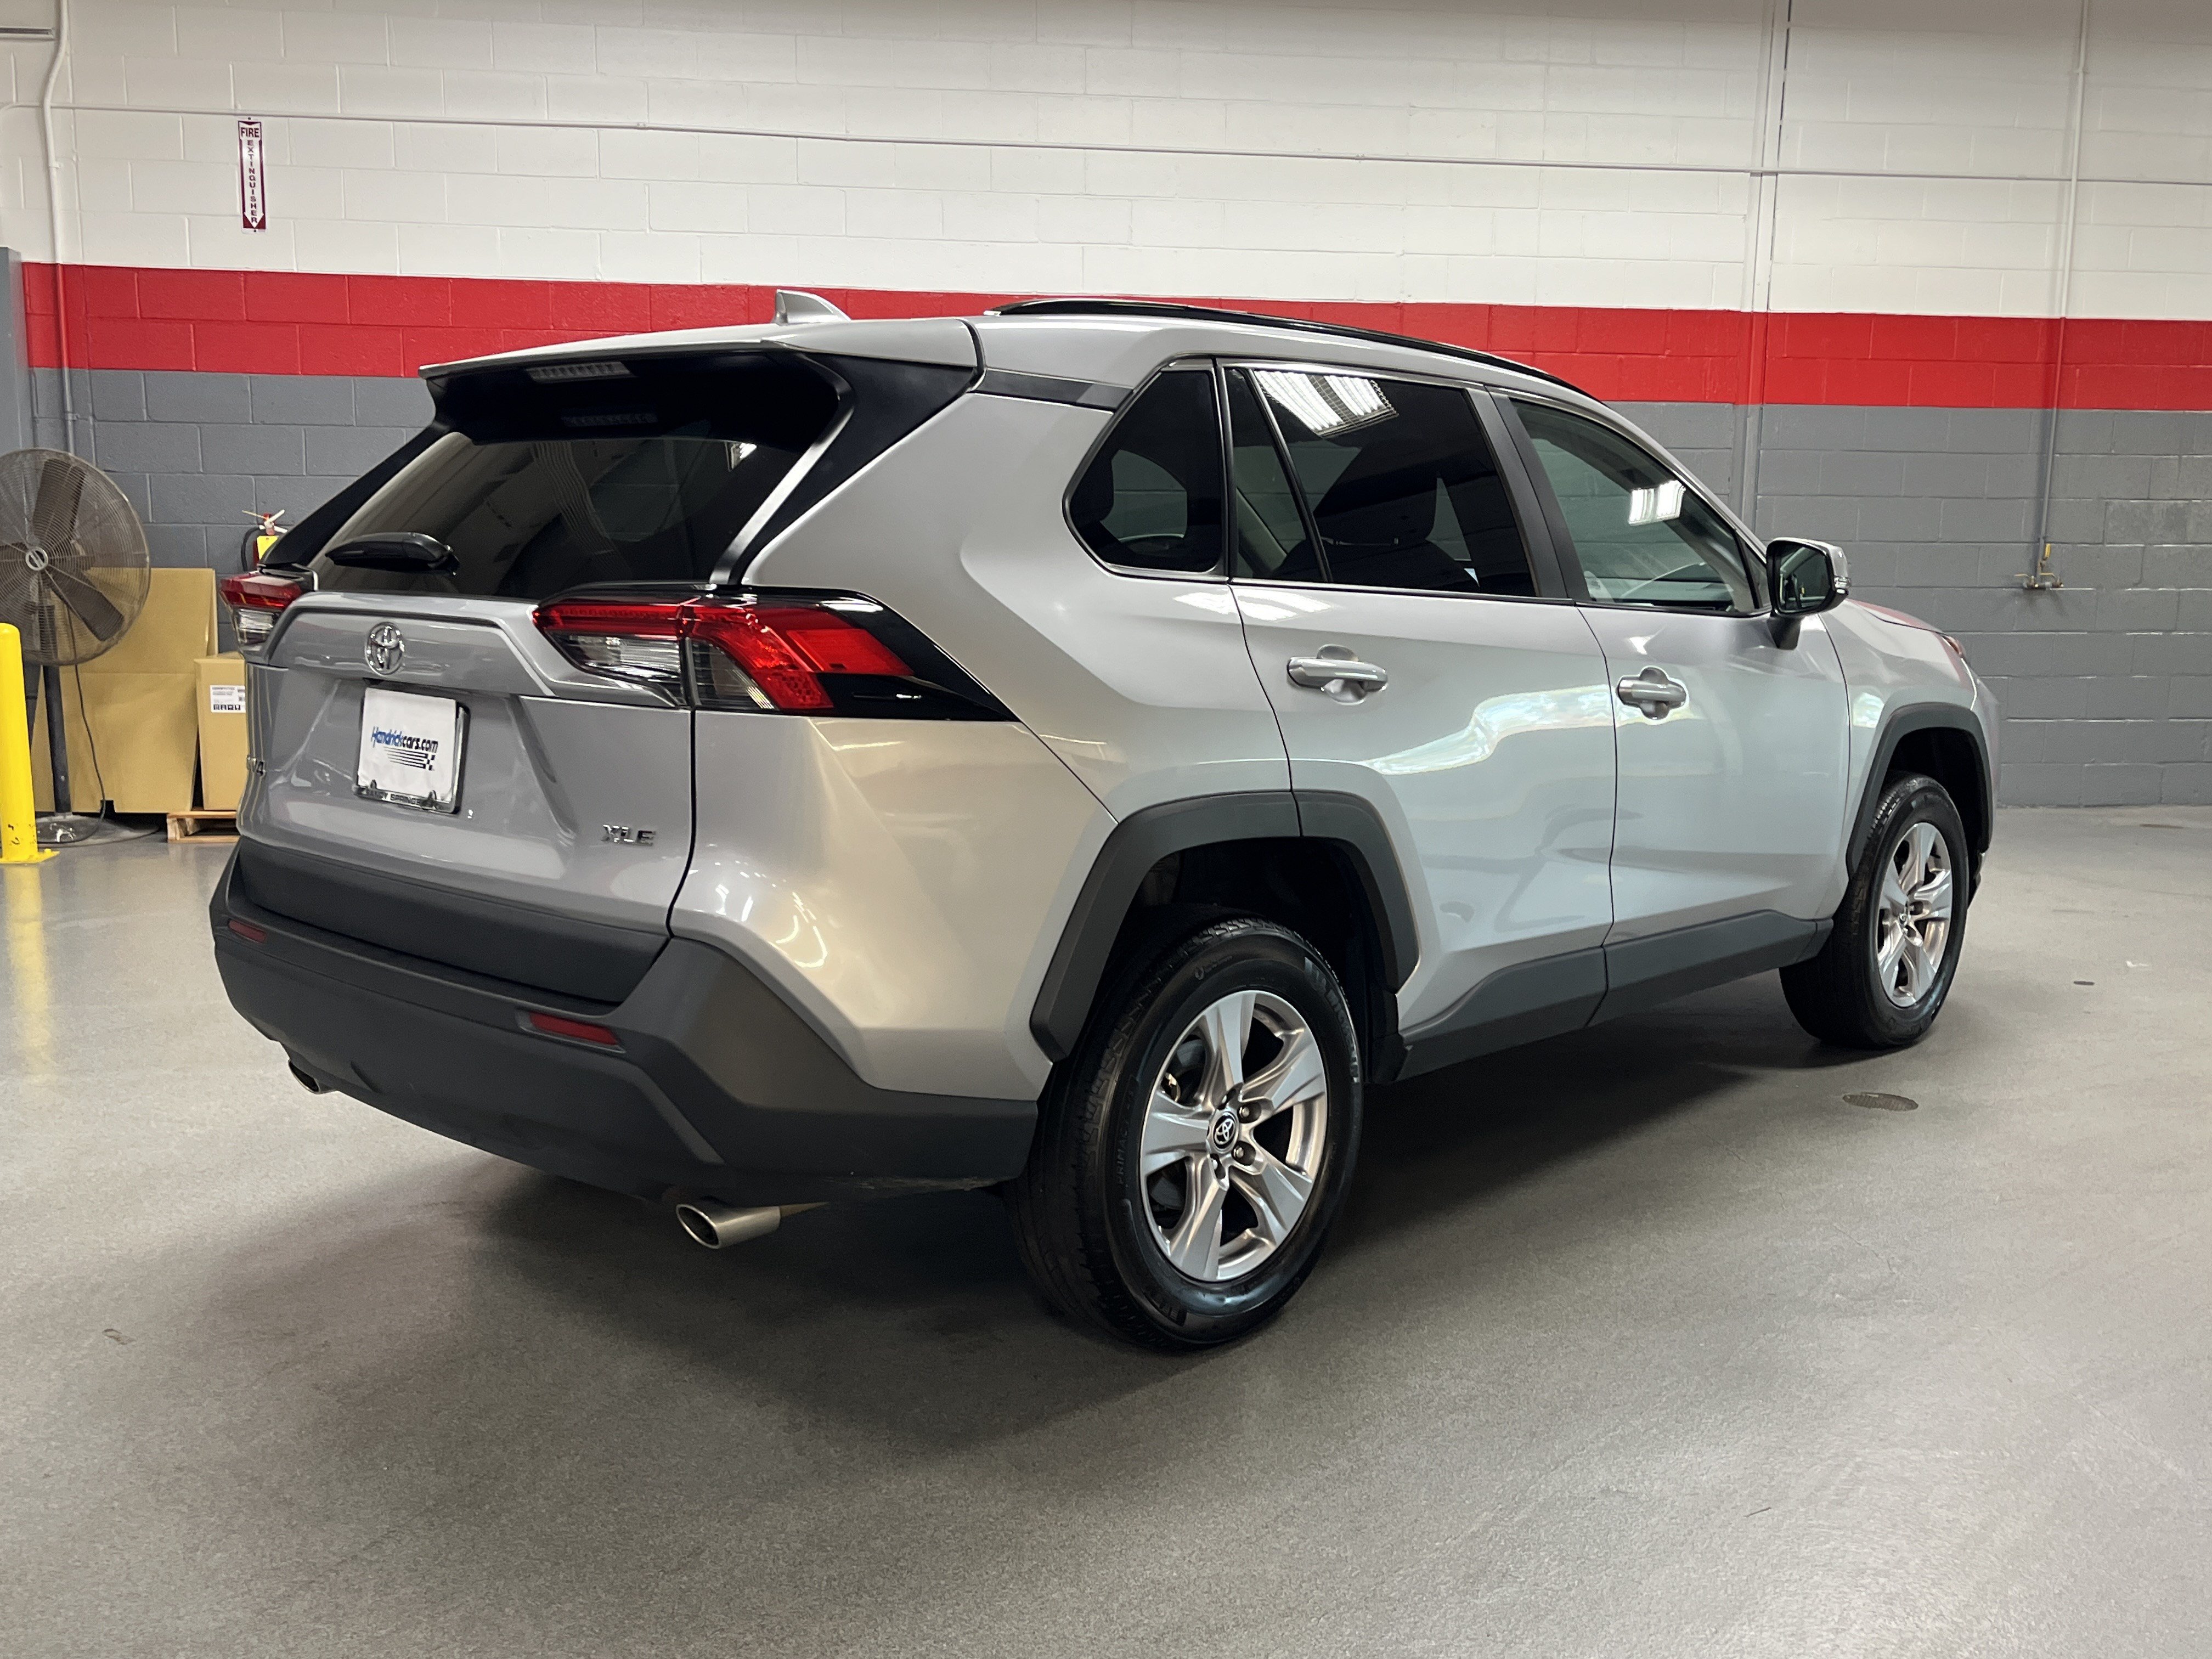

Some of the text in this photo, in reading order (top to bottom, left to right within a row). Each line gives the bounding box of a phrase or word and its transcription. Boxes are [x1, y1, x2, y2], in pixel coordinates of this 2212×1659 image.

[241, 127, 259, 137] FIRE
[247, 140, 258, 223] EXTINGUISHER
[601, 824, 656, 846] XLE
